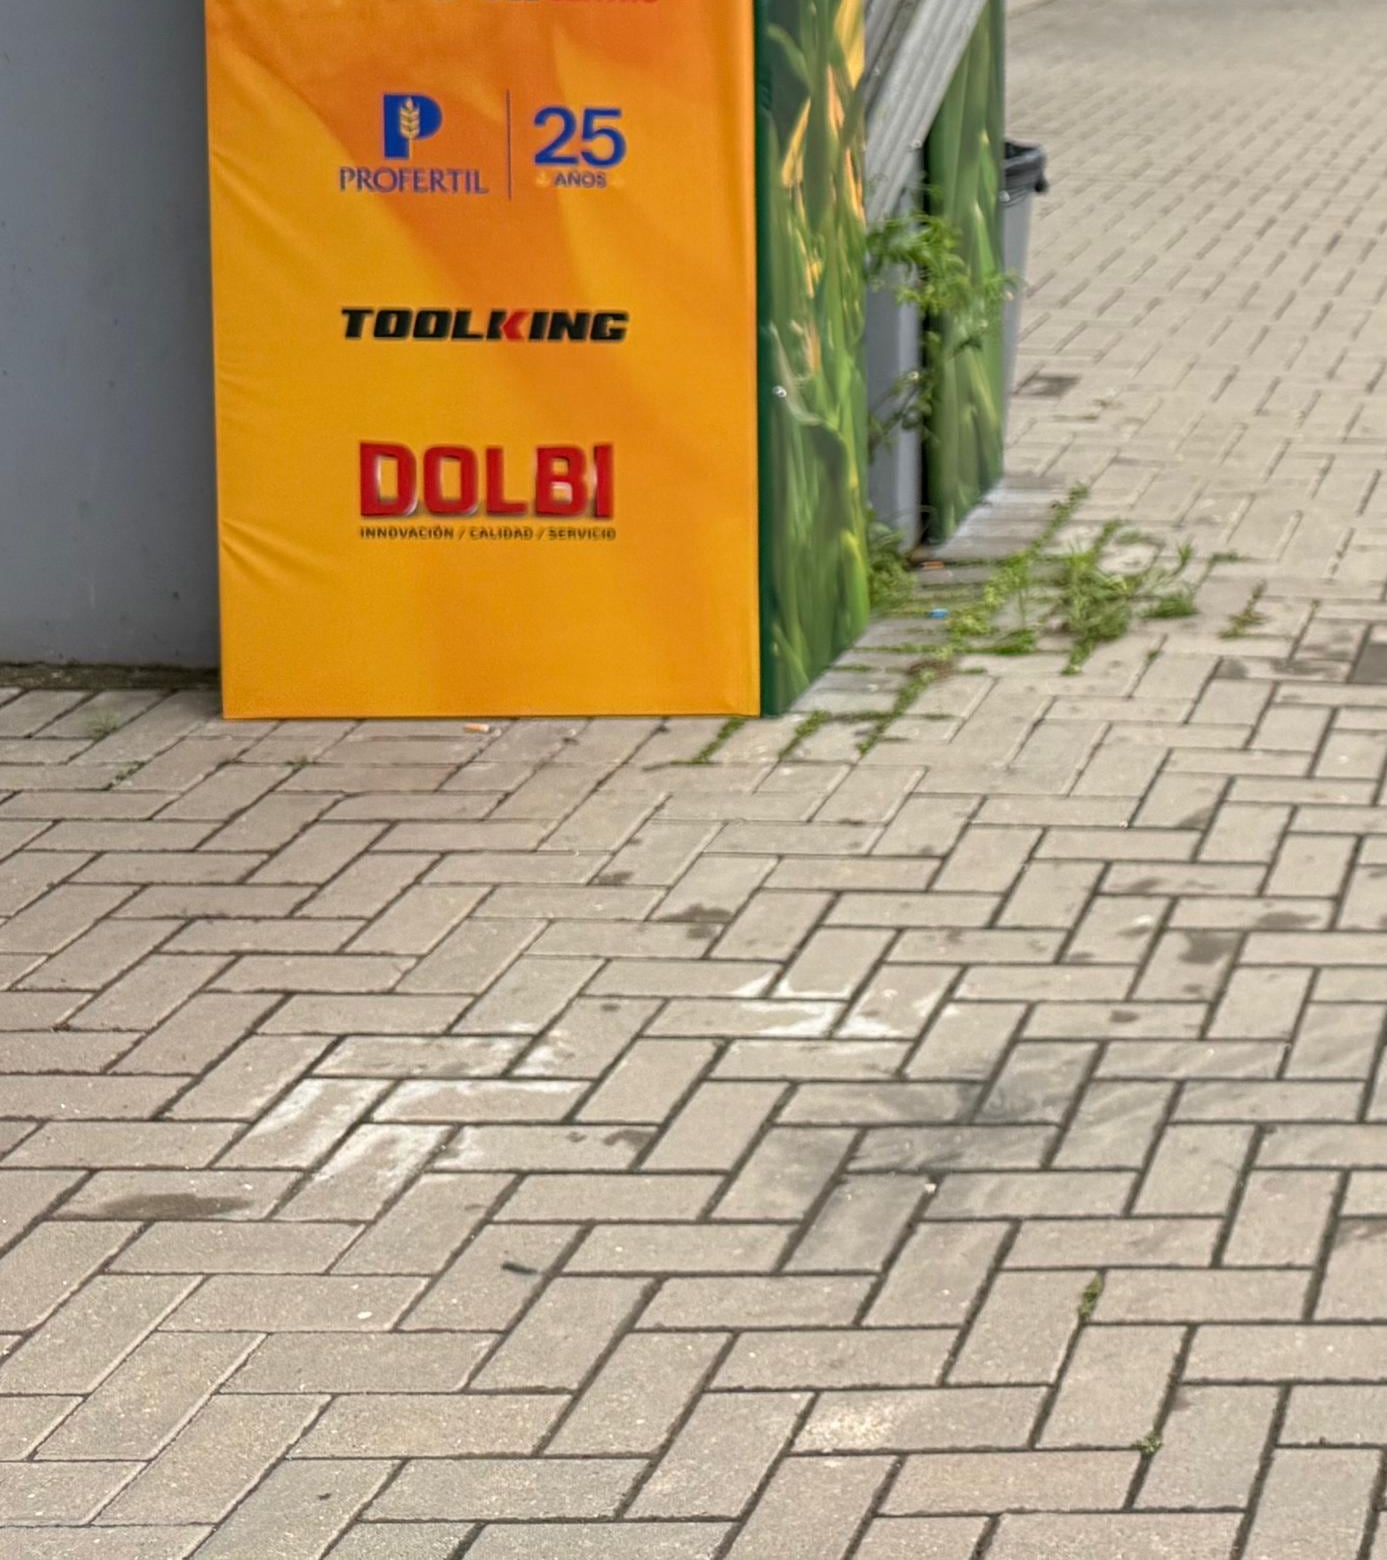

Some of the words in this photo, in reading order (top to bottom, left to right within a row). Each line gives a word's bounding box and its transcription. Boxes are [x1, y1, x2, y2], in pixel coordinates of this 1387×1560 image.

[533, 105, 628, 167] 25
[339, 166, 490, 195] PROFERTIL
[553, 170, 608, 188] AÑOS
[341, 308, 630, 342] TOOLKING
[360, 441, 615, 520] DOLBI
[360, 525, 454, 540] INNOVACIÓN
[469, 526, 534, 540] CALIDAD
[547, 526, 617, 541] SERVICIO
